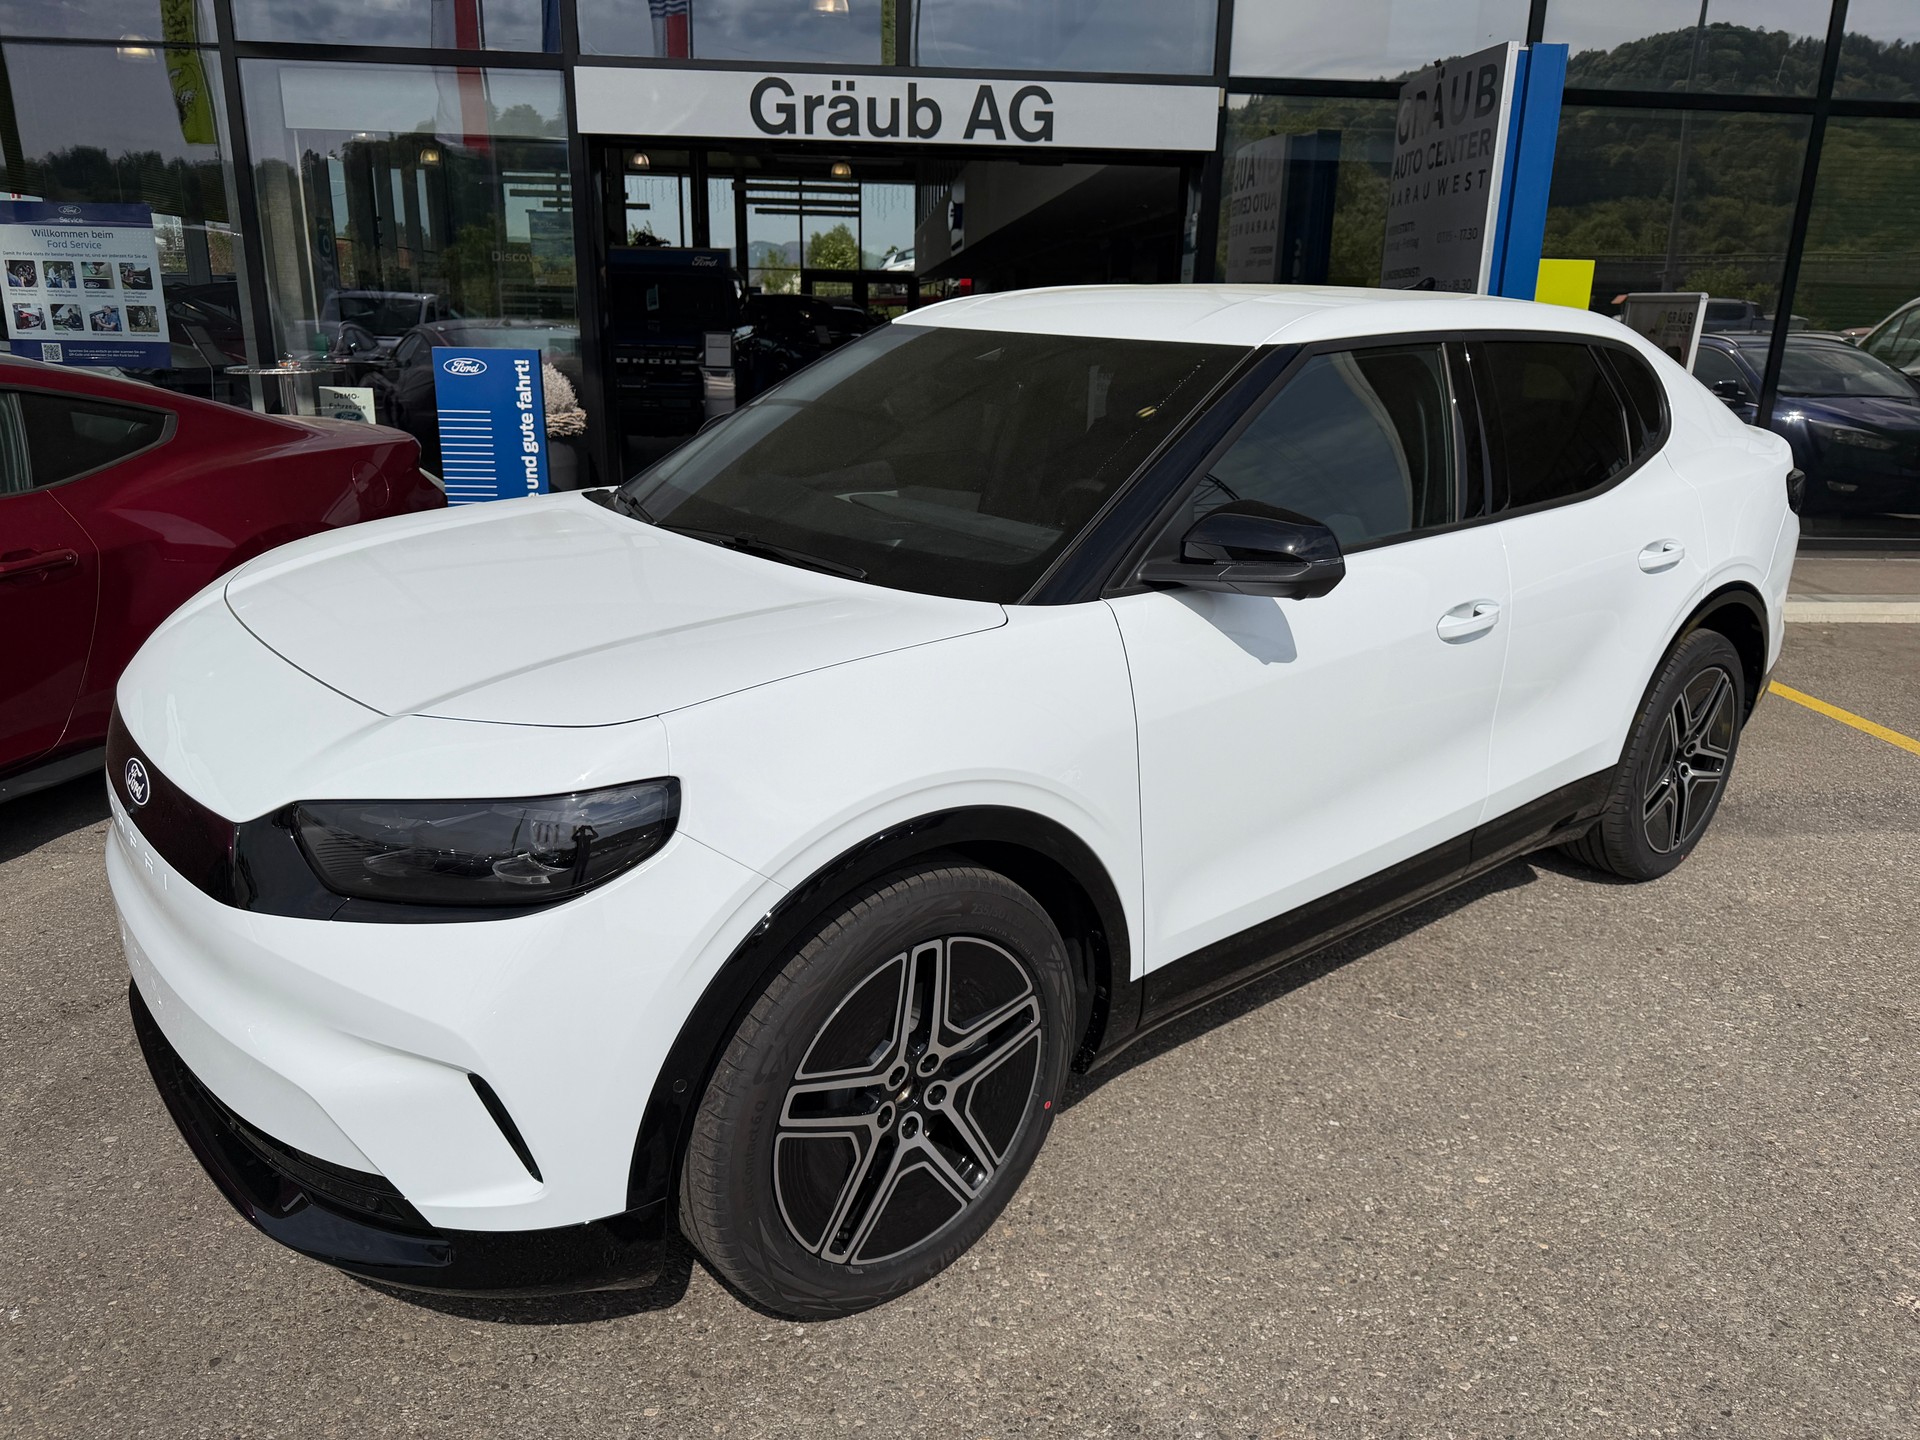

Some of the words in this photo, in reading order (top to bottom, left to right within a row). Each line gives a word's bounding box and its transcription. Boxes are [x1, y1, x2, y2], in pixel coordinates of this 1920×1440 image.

[750, 76, 942, 138] Gräub
[963, 84, 1054, 142] AG
[1398, 63, 1497, 145] GRÄUB
[1393, 149, 1422, 180] AUTO
[1427, 127, 1492, 170] CENTER
[1390, 181, 1430, 208] AARAU
[1437, 168, 1487, 195] WEST
[31, 229, 90, 239] Willkommen
[91, 230, 114, 239] beim
[59, 216, 84, 224] Service
[47, 240, 67, 249] Ford
[70, 240, 102, 250] Service
[692, 255, 719, 267] Ford
[1667, 308, 1694, 325] GRÄUB
[451, 360, 480, 373] Ford
[514, 359, 533, 411] fahrt!
[519, 412, 540, 454] gute
[521, 455, 540, 489] und
[127, 763, 145, 800] Ford
